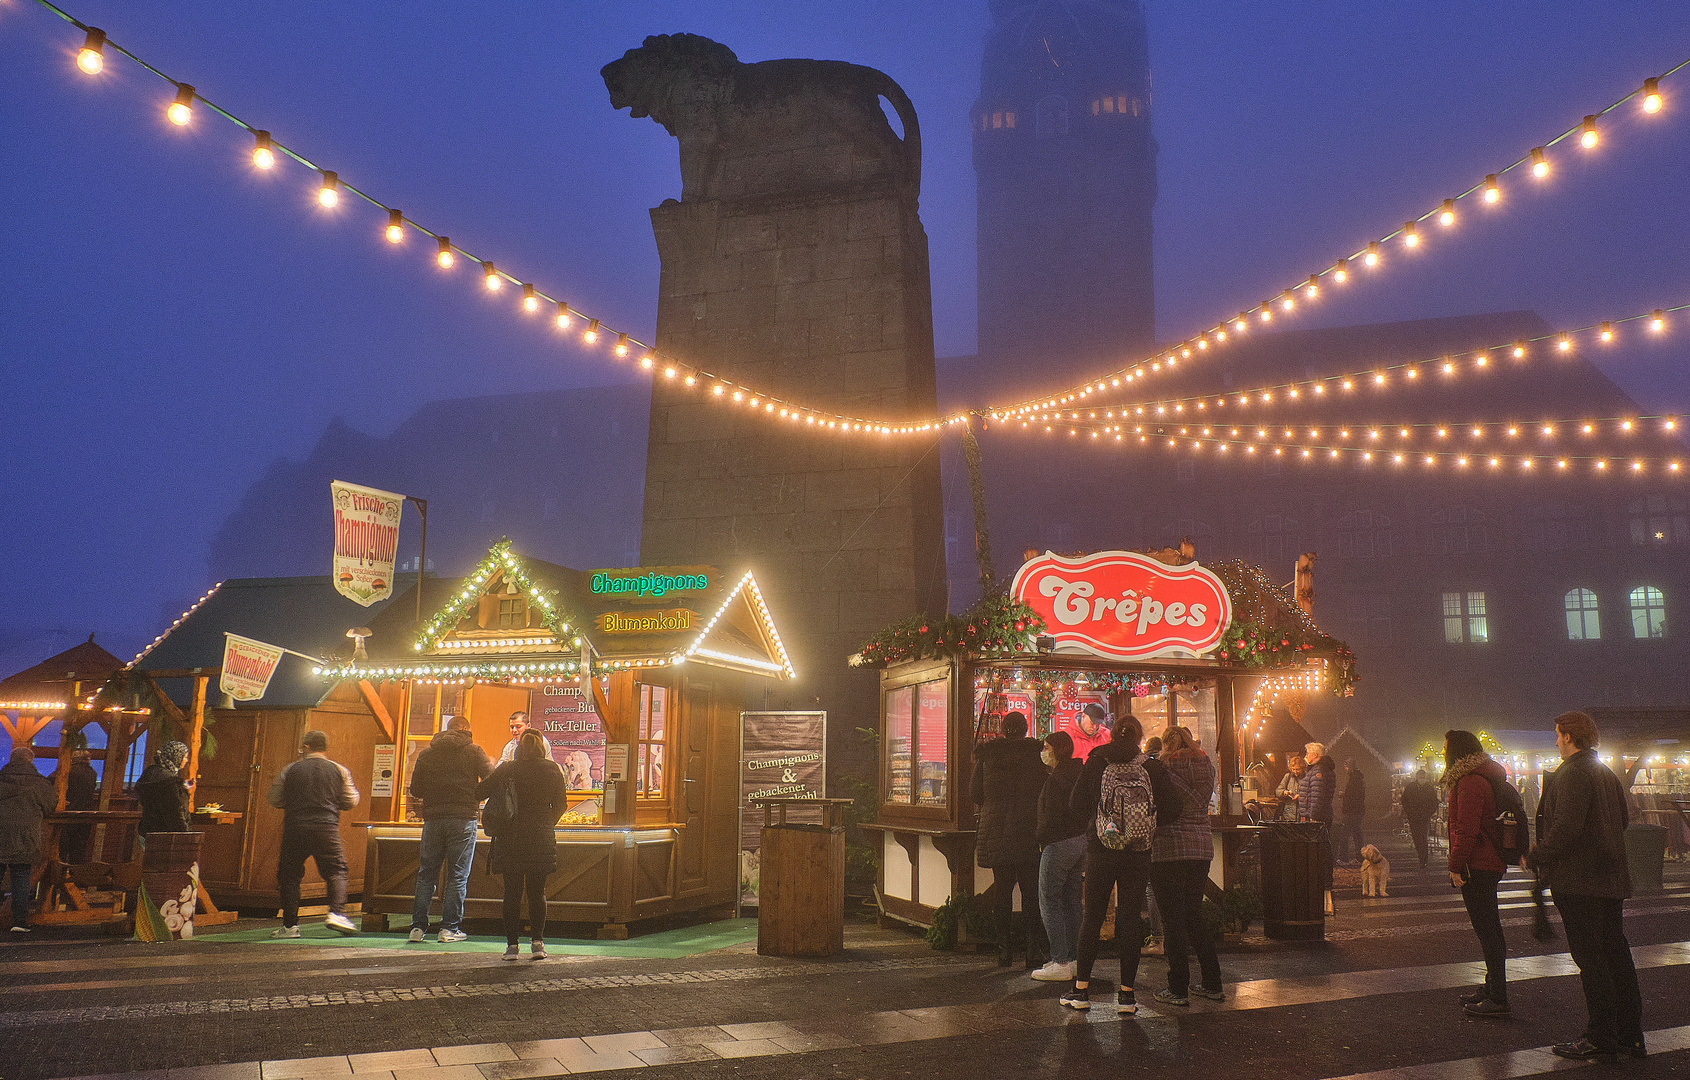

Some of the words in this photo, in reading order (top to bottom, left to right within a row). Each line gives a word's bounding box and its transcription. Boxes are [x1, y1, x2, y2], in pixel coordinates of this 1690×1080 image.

[352, 493, 385, 515] Frische
[336, 509, 398, 566] Champignons
[351, 567, 387, 577] verschiedenen
[356, 574, 372, 583] Soßen
[590, 572, 707, 597] Champignons
[1038, 575, 1207, 636] Crêpes
[603, 611, 690, 631] Blumenkohl
[238, 644, 270, 657] GEBACKENER
[225, 648, 276, 683] Blumenkohl
[544, 706, 575, 715] gebackener
[543, 720, 597, 732] Mix-Teller
[747, 752, 819, 771] Champignons
[781, 768, 797, 783] &
[747, 784, 806, 802] gebackener
